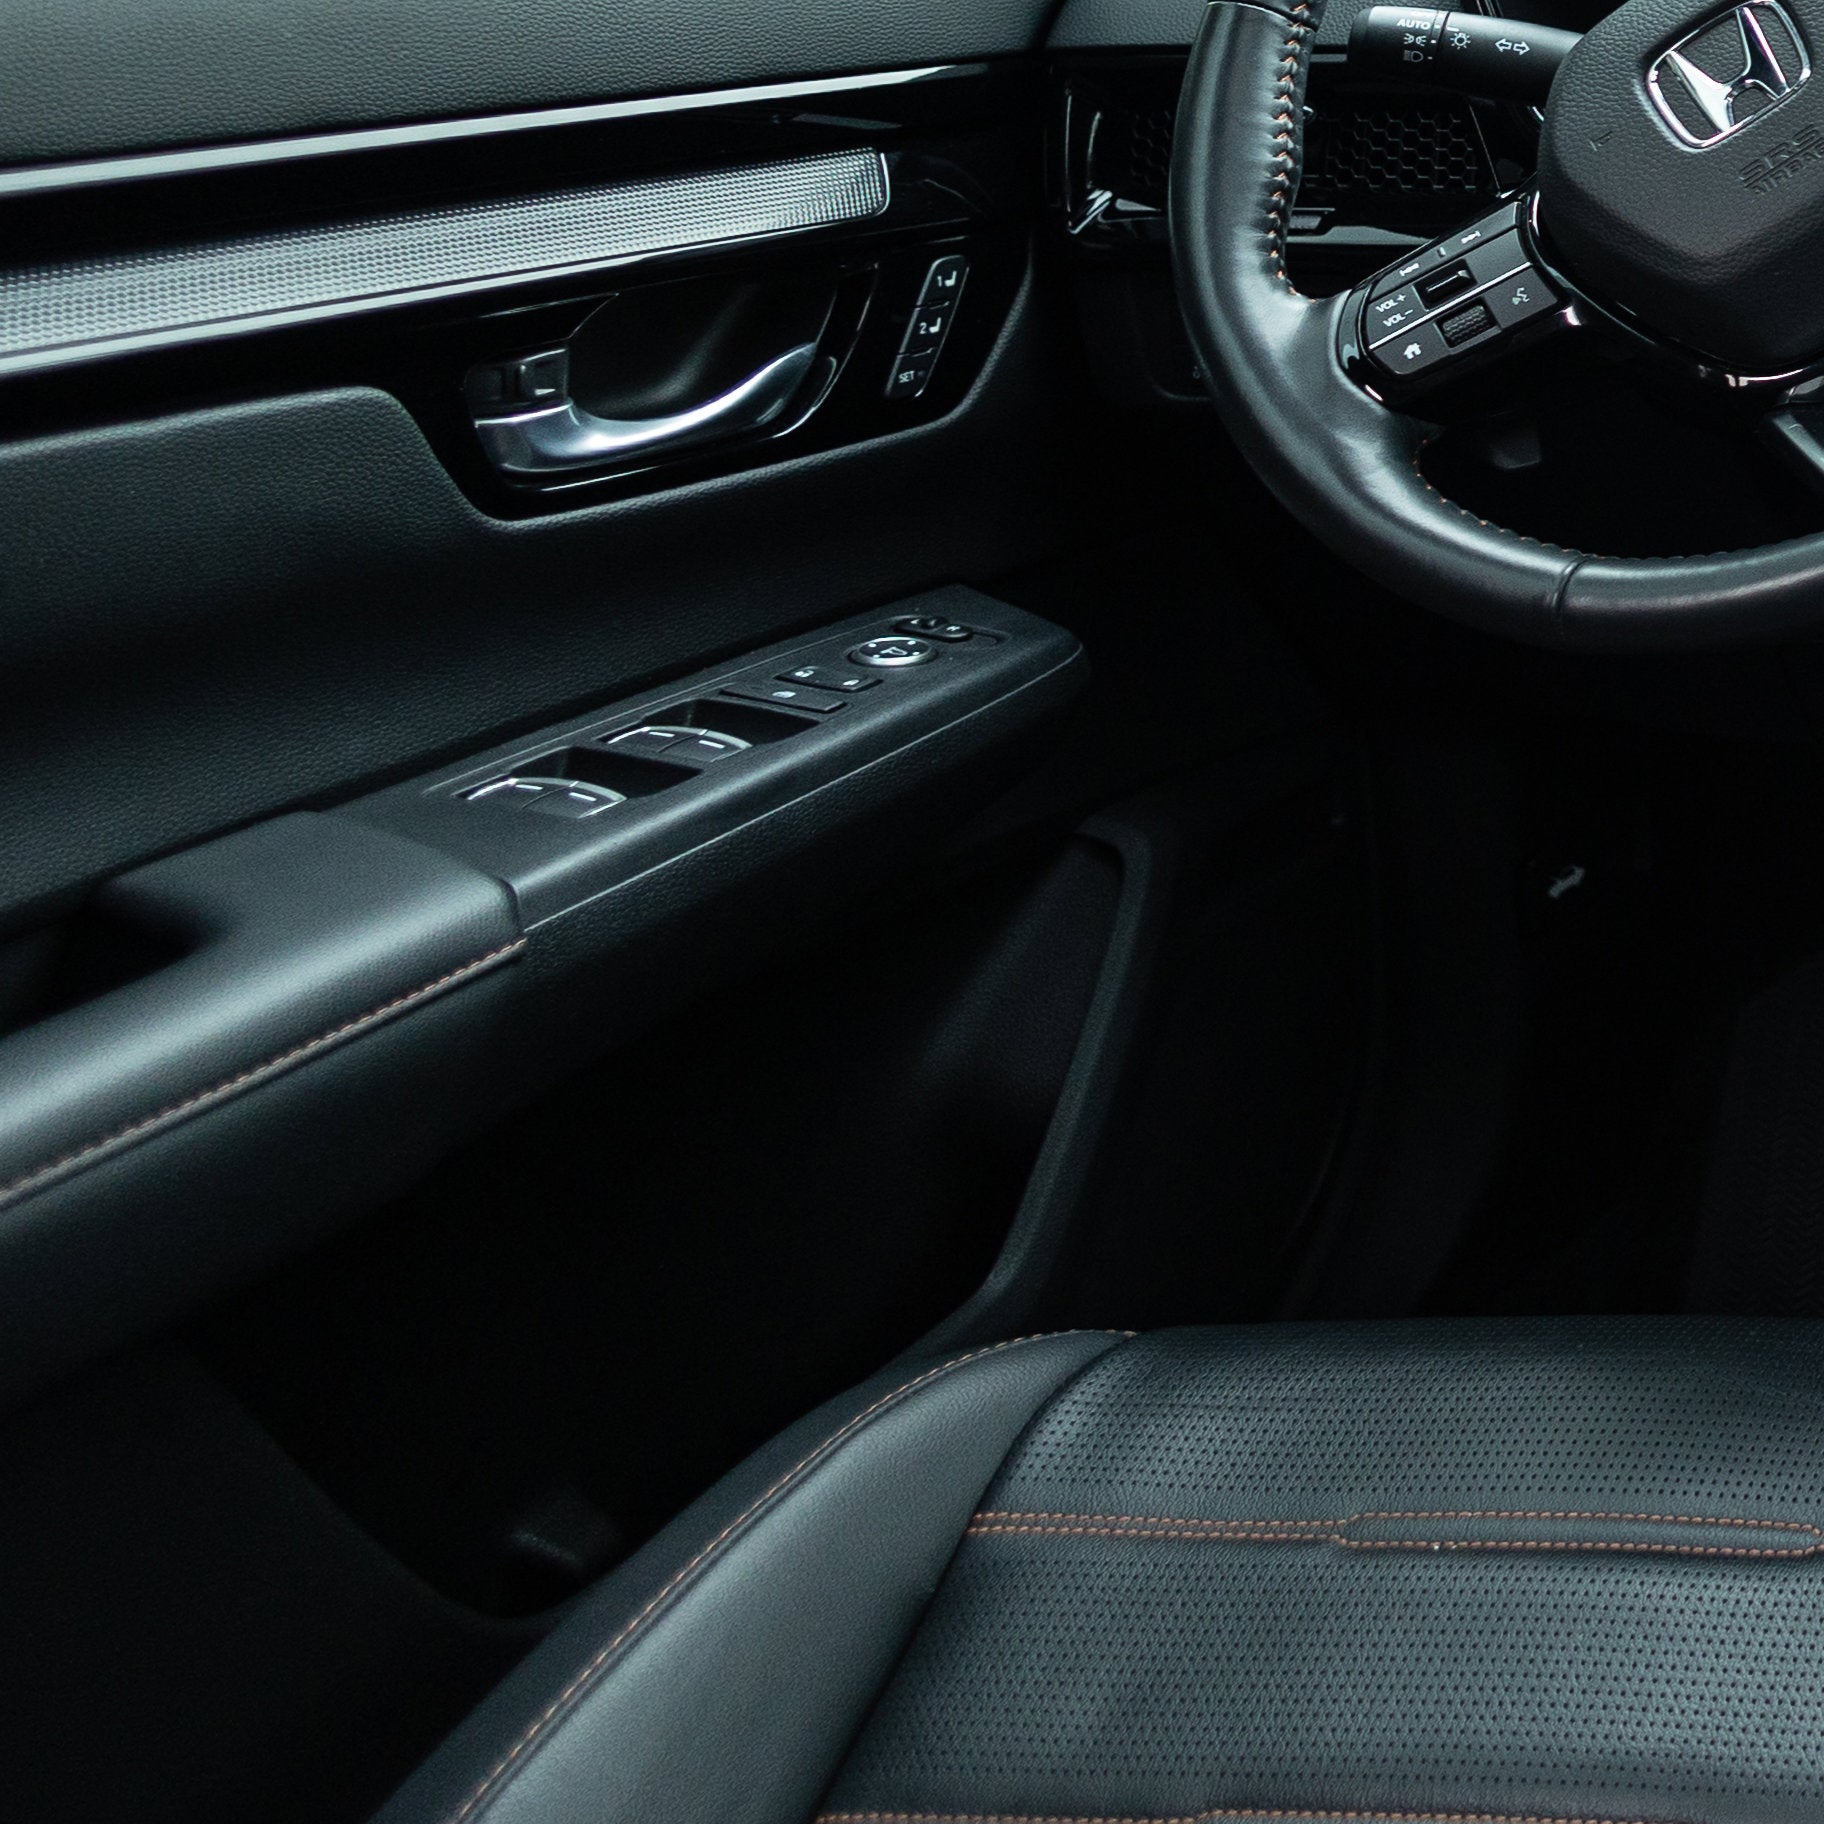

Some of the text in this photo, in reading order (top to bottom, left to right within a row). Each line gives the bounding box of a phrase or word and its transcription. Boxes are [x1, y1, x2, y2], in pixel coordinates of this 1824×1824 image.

[1396, 18, 1431, 31] AUTO
[1737, 124, 1821, 183] SRS
[897, 369, 916, 384] SET
